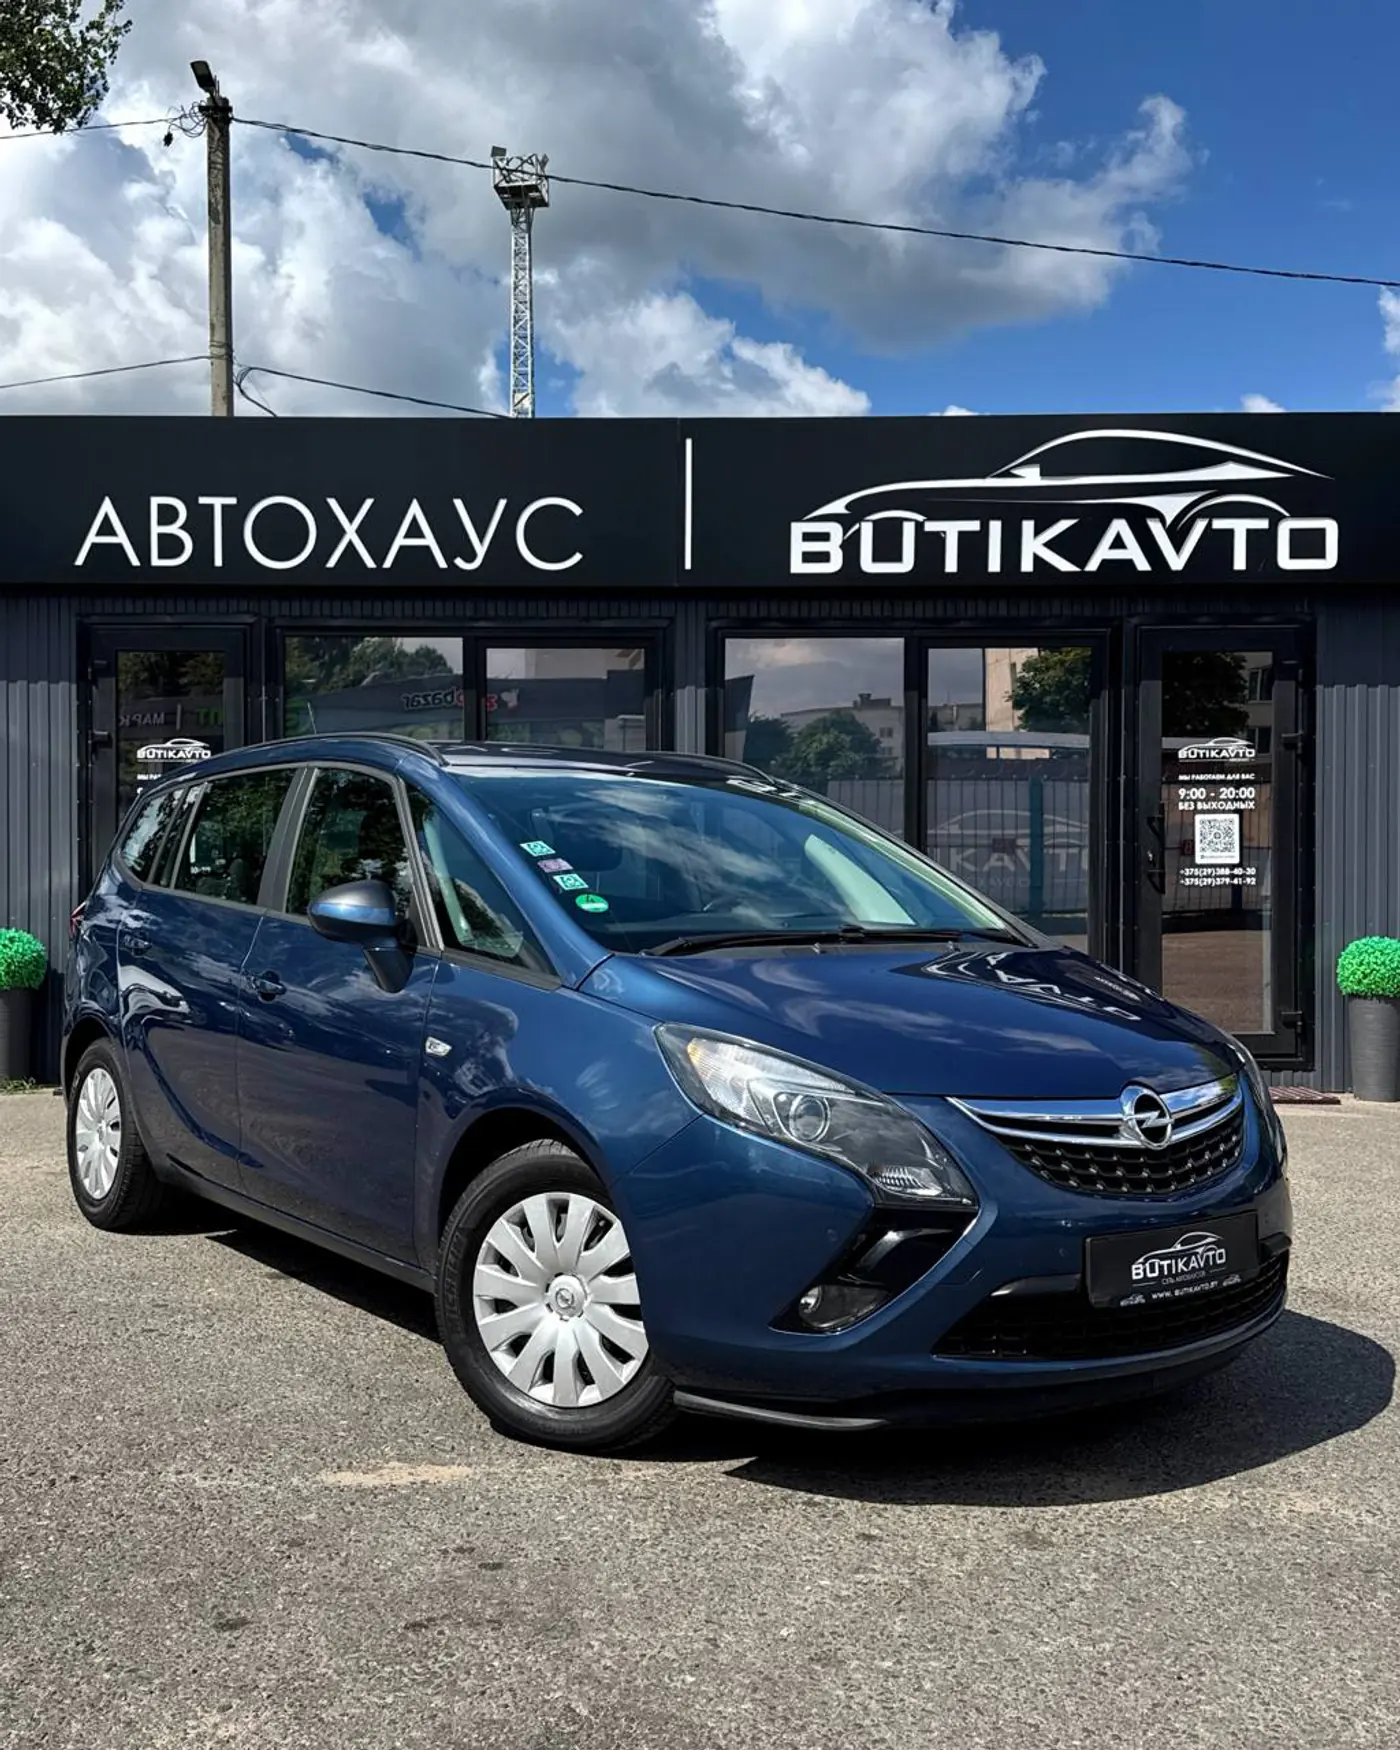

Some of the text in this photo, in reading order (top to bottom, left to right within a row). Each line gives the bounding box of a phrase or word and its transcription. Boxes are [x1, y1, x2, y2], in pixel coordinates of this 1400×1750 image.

[74, 496, 586, 572] АВТОХАУС
[789, 516, 1339, 575] BUTIKAVTO
[137, 748, 211, 759] BUTIKAVTO
[1178, 748, 1256, 759] BUTIKAVTO
[1178, 787, 1206, 800] 9:00
[1219, 787, 1255, 799] 20:00
[1178, 801, 1255, 811] БЕЗ ВЫХОДНЫХ
[1131, 1248, 1227, 1281] BUTIKAVTO
